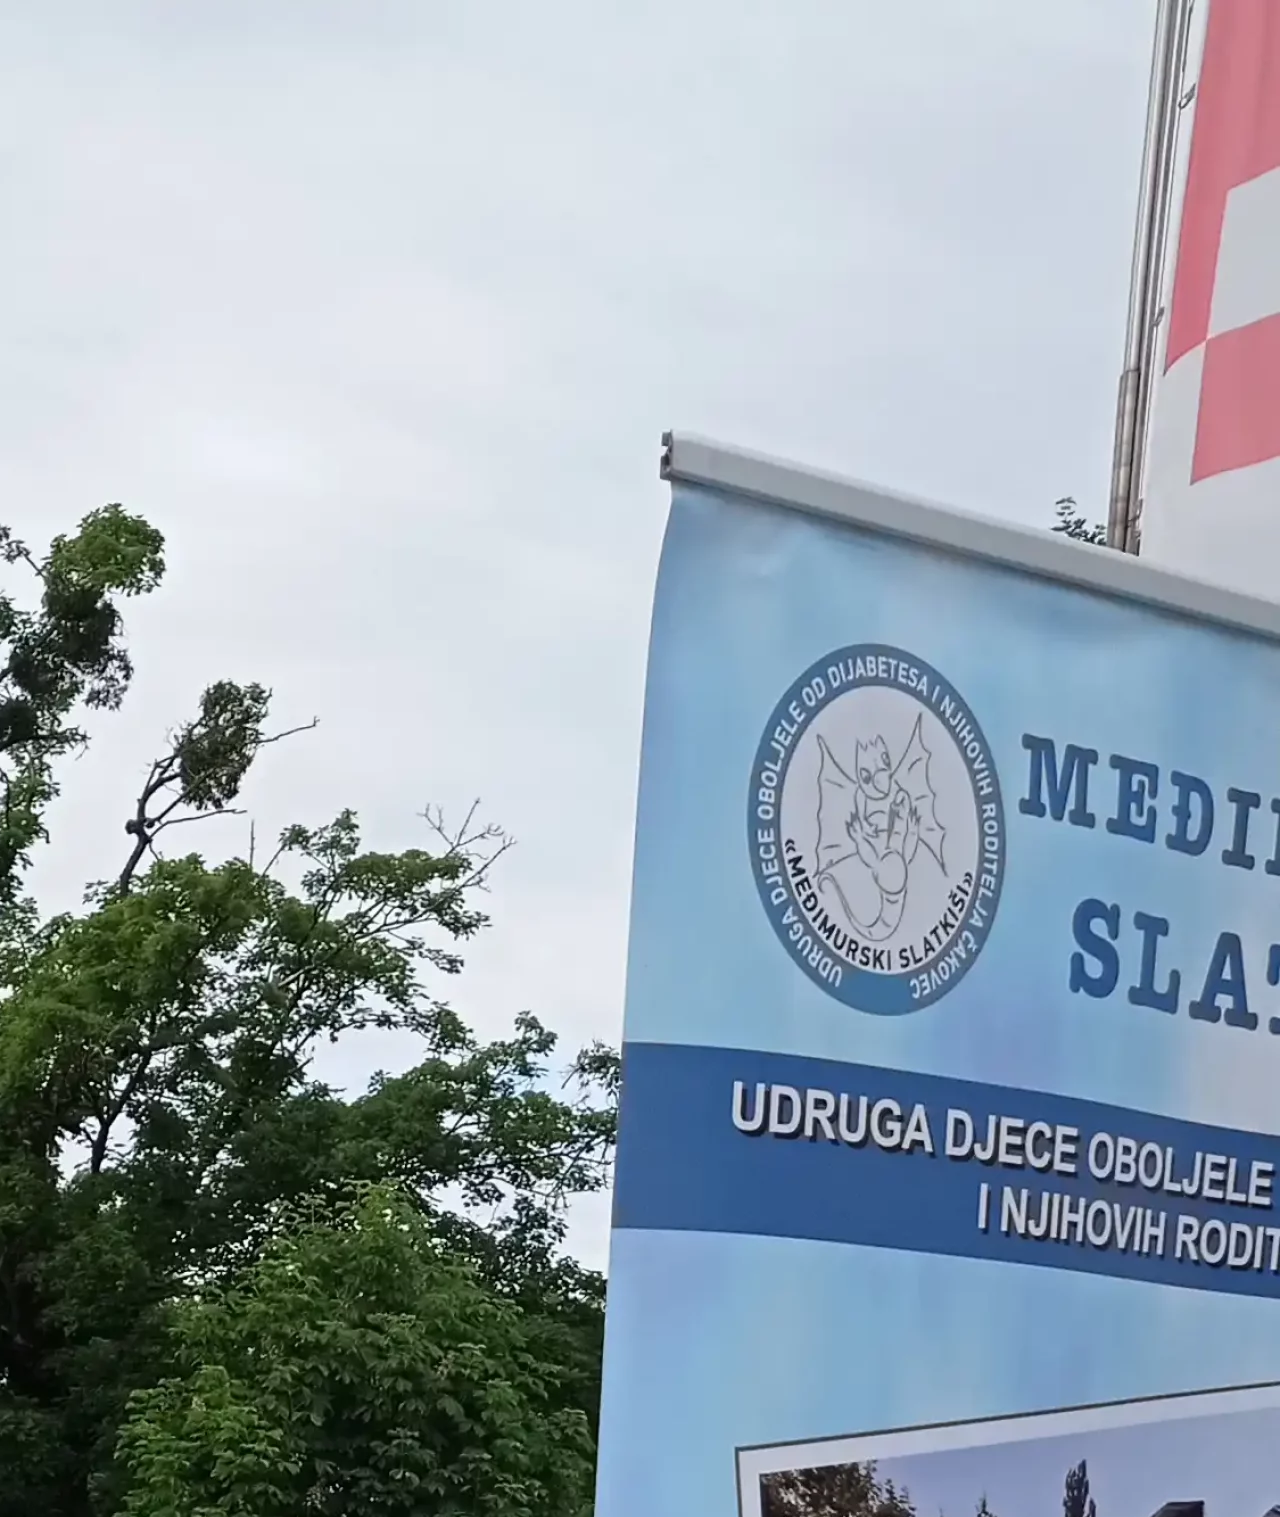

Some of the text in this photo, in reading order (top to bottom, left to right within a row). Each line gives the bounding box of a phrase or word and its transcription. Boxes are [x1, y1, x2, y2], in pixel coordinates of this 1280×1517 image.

[802, 676, 827, 708] OD
[827, 655, 929, 694] DIJABETESA
[757, 700, 805, 820] OBOLJELE
[940, 698, 993, 796] NJIHOVIH
[1018, 733, 1280, 876] MEĐI
[757, 828, 788, 907] DJECE
[969, 803, 997, 926] RODITELJA
[781, 908, 843, 987] UDRUGA
[909, 932, 978, 999] ČAKOVEC
[1069, 897, 1280, 1036] SLA
[731, 1079, 1275, 1205] UDRUGA DJECE OBOLJELE
[978, 1184, 989, 1228] I
[1001, 1185, 1164, 1256] NJIHOVIH
